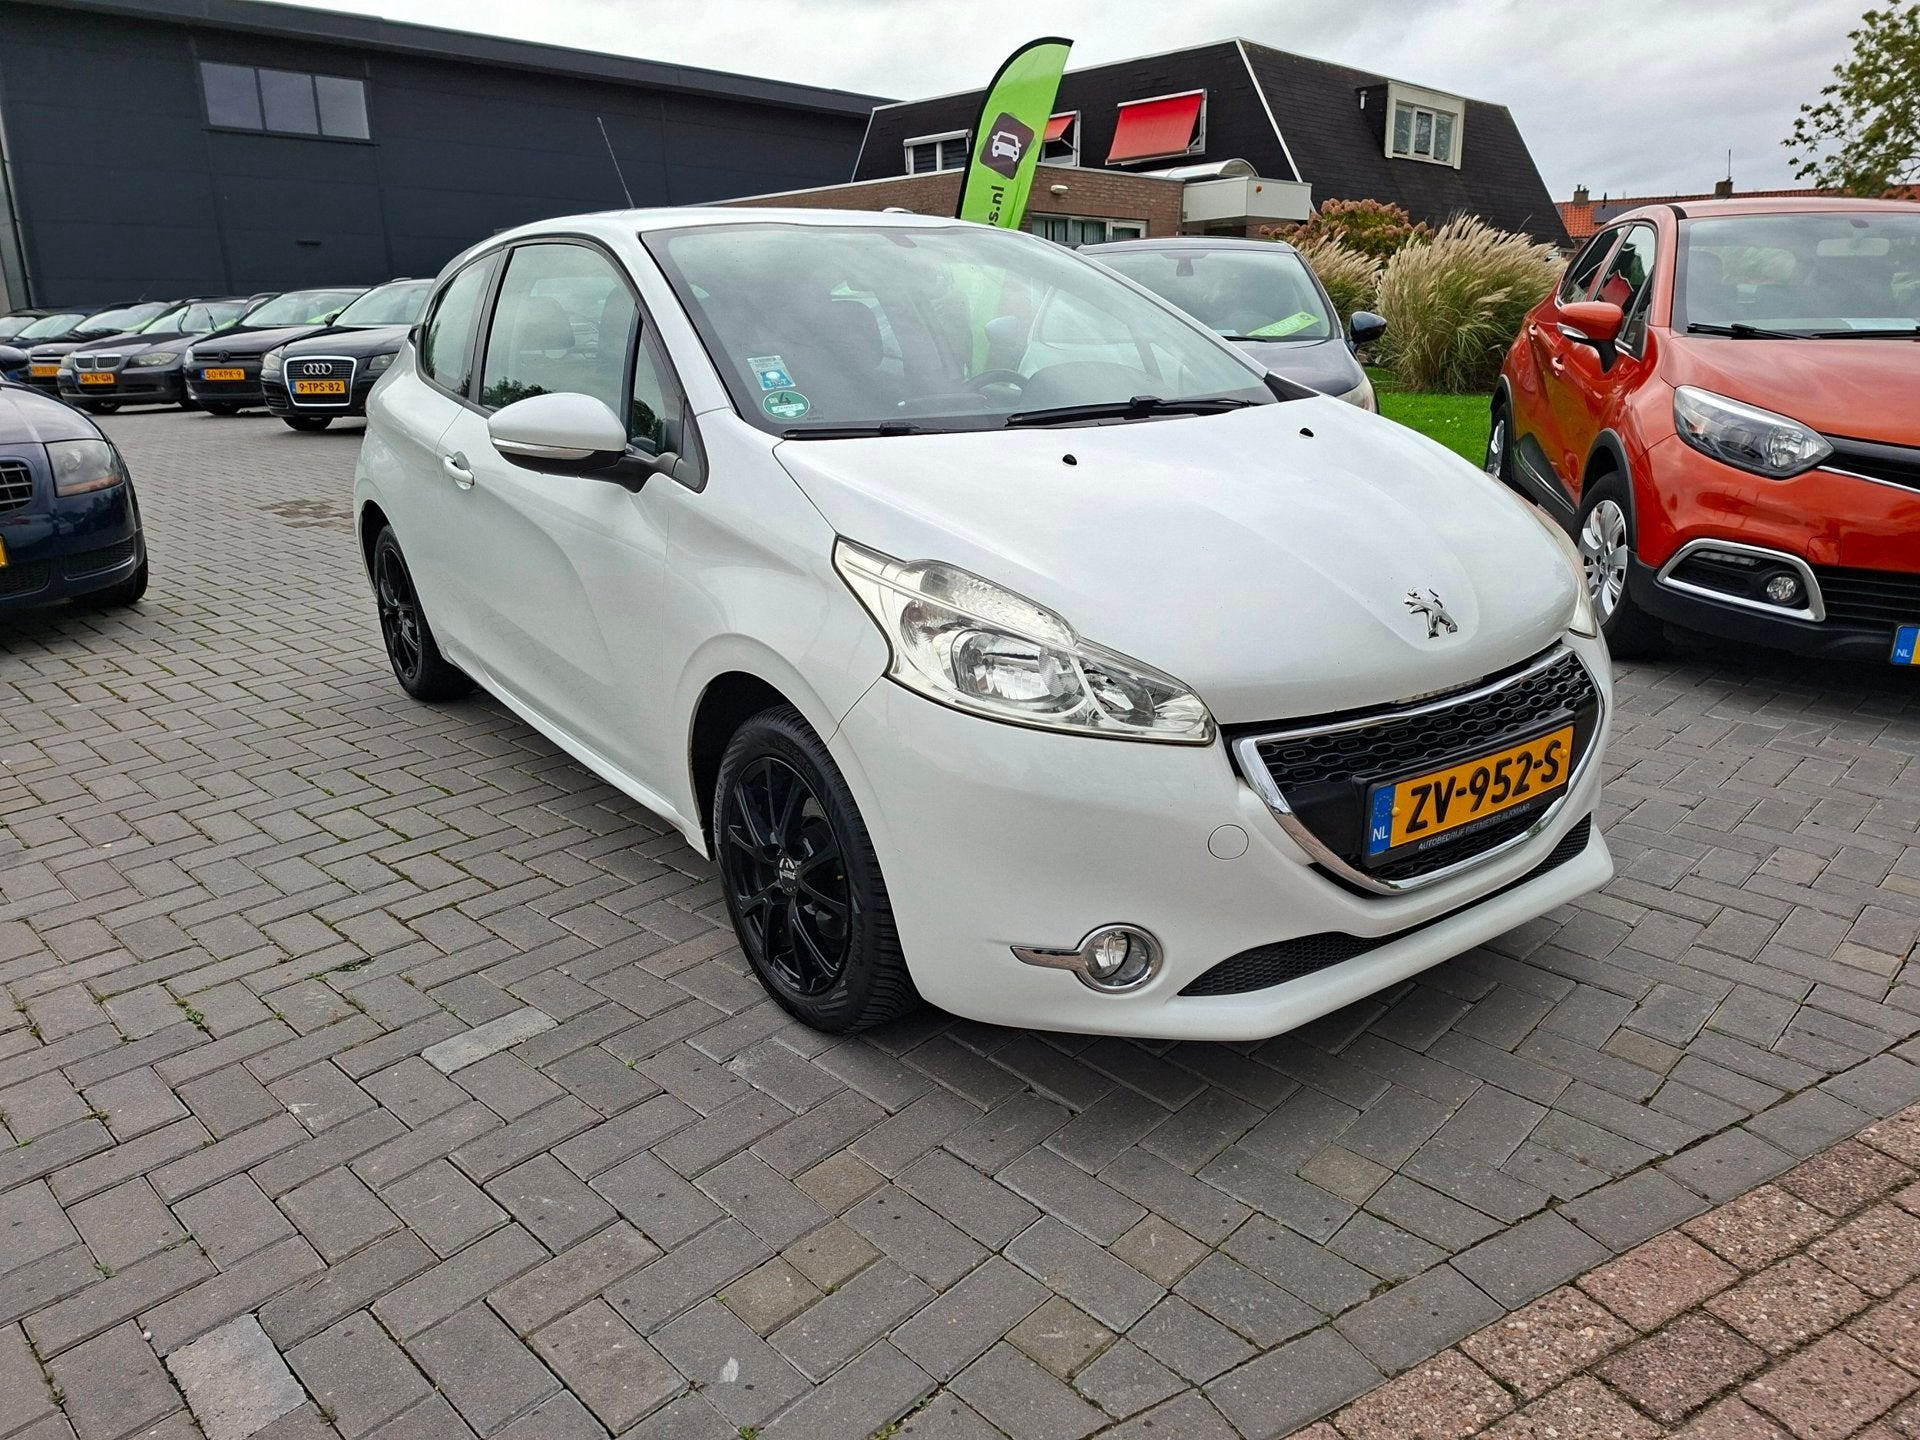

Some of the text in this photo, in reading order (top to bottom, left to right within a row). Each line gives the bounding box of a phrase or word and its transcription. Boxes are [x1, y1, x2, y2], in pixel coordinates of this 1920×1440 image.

[299, 382, 341, 392] 9-TPS-82
[1896, 648, 1910, 658] NL
[1406, 740, 1561, 834] ZV-952-S
[1372, 825, 1389, 842] NL
